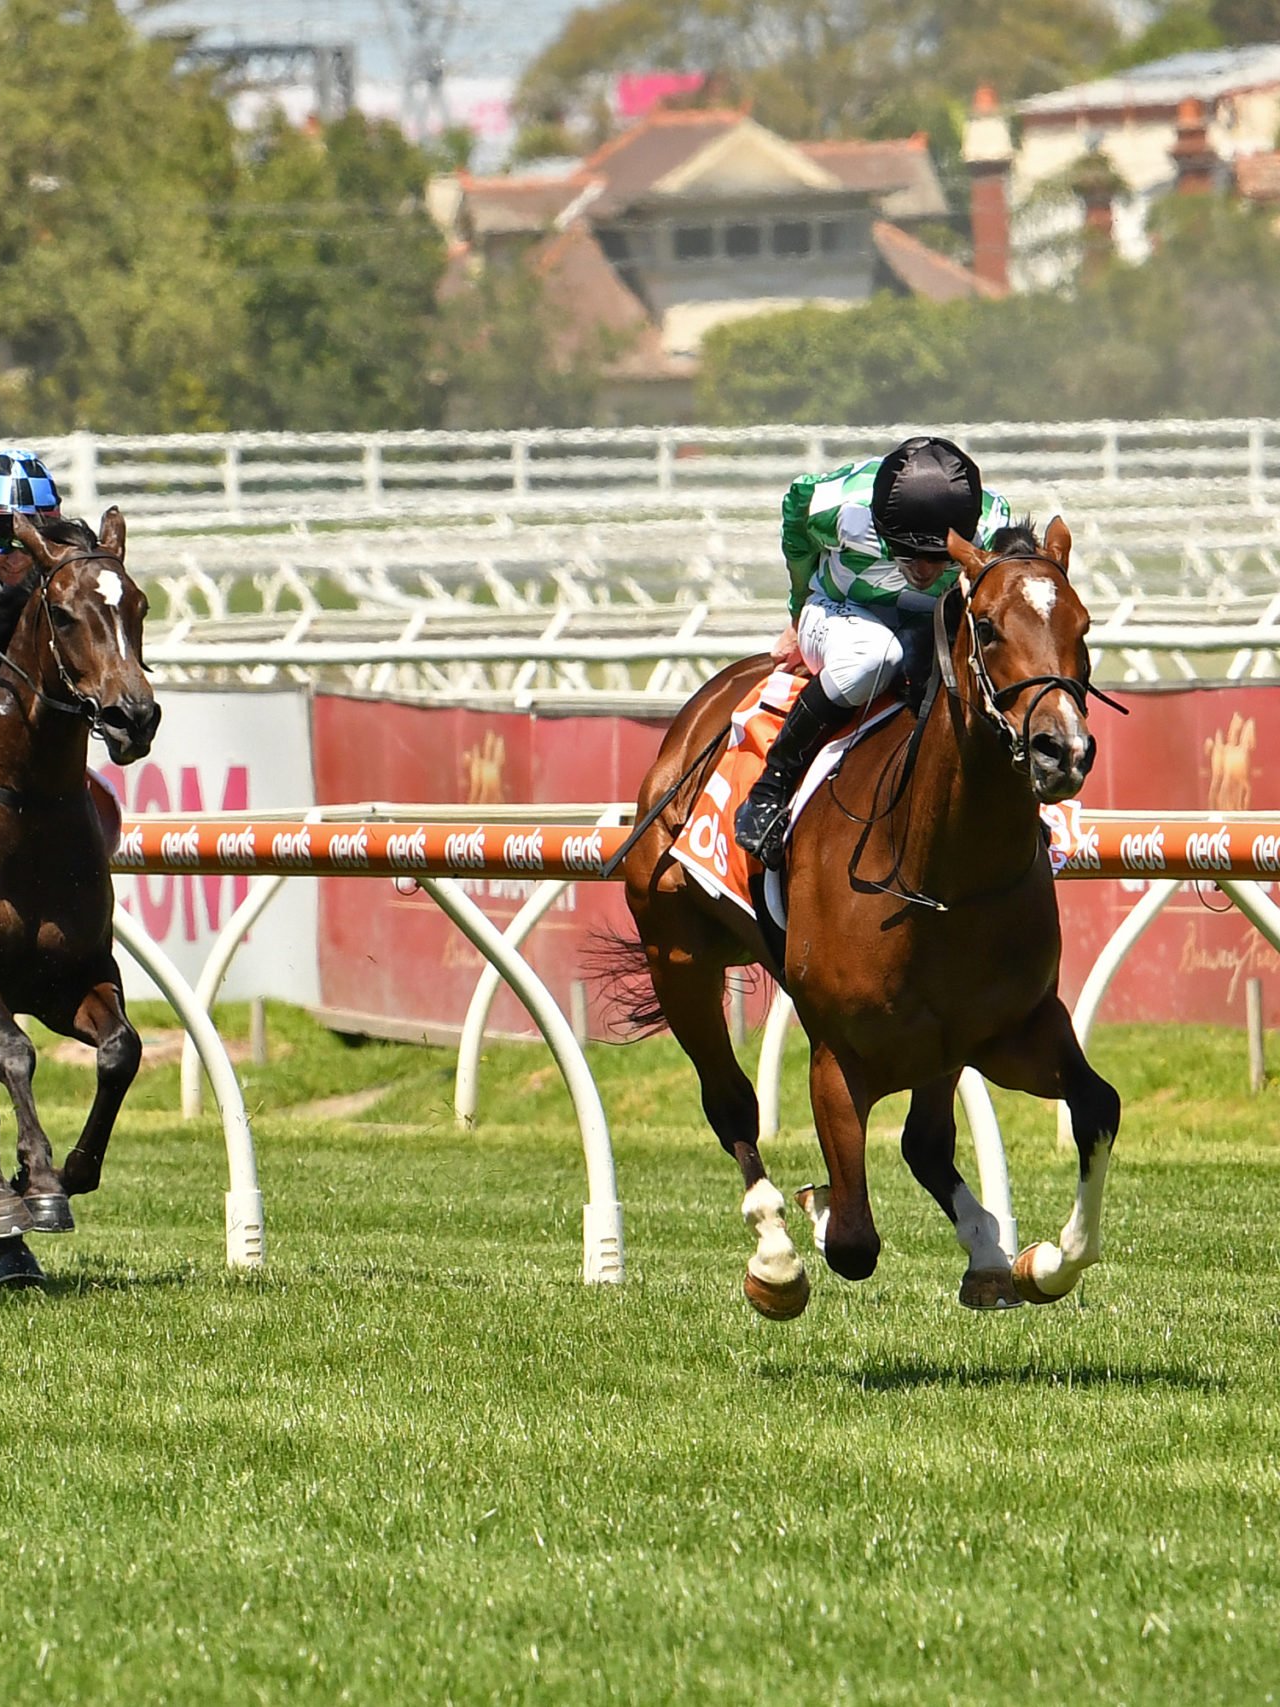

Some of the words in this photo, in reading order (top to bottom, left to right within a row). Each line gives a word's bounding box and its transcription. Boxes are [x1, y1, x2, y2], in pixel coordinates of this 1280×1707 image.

[161, 825, 200, 866] neds
[217, 825, 256, 867] neds
[272, 826, 312, 867] neds
[328, 827, 369, 868] neds
[386, 827, 427, 868] neds
[445, 826, 485, 869] neds
[503, 828, 544, 870] neds
[1120, 825, 1166, 870] neds
[1186, 825, 1232, 870] neds
